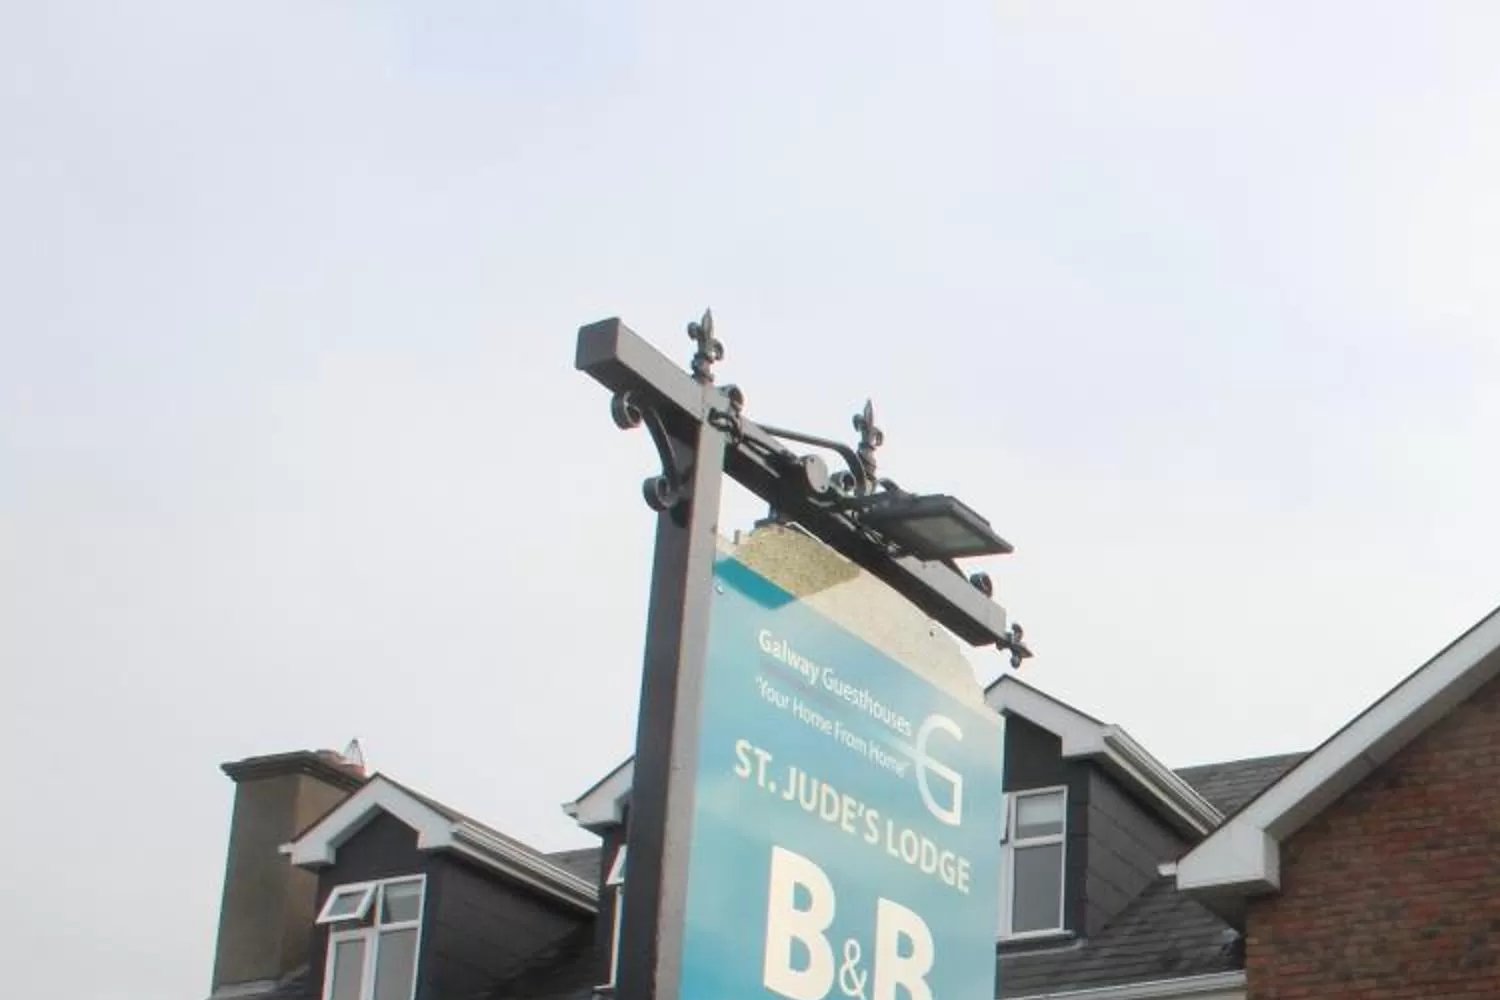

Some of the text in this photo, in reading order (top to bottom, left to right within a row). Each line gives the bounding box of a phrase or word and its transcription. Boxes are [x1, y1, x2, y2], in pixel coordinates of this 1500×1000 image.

[758, 629, 912, 737] Galway Guesthouses
[792, 696, 833, 735] Home
[833, 720, 867, 756] From
[734, 739, 971, 893] ST. JUDE'S LODGE
